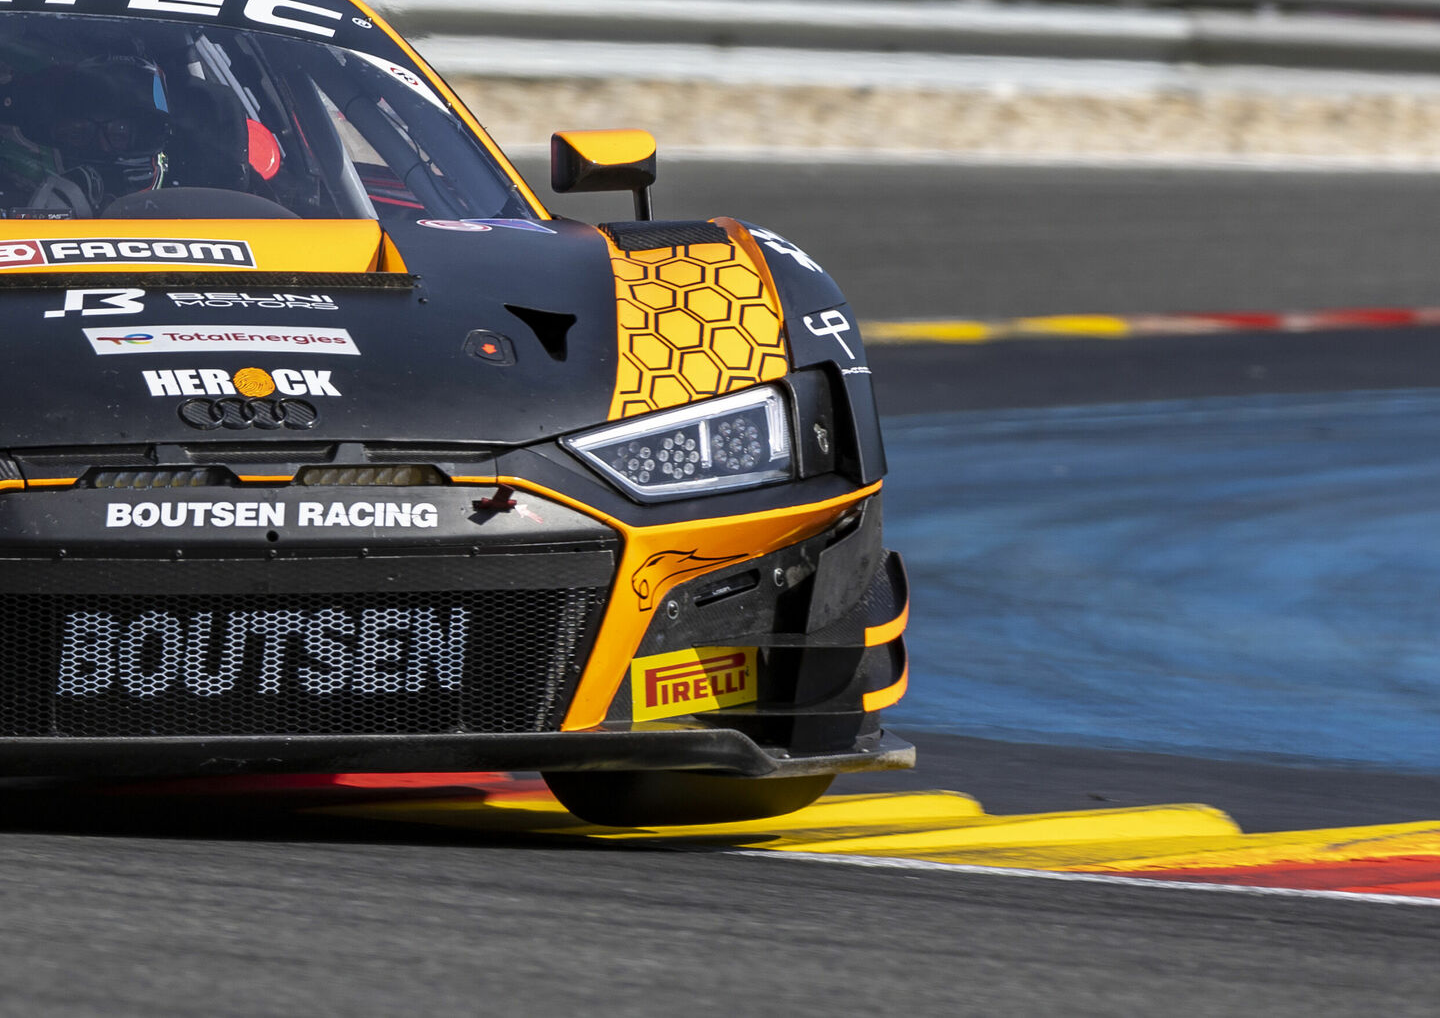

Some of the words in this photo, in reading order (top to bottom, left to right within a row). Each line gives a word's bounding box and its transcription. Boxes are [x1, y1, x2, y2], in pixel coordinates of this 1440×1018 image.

[49, 242, 246, 262] FACOM
[165, 292, 334, 302] BELINI
[173, 300, 340, 310] MOTORS
[162, 332, 348, 345] TotalEnergies
[106, 502, 286, 528] BOUTSEN
[298, 502, 439, 528] RACING
[57, 607, 471, 697] BOUTSEN
[645, 652, 746, 708] PIRELLI
